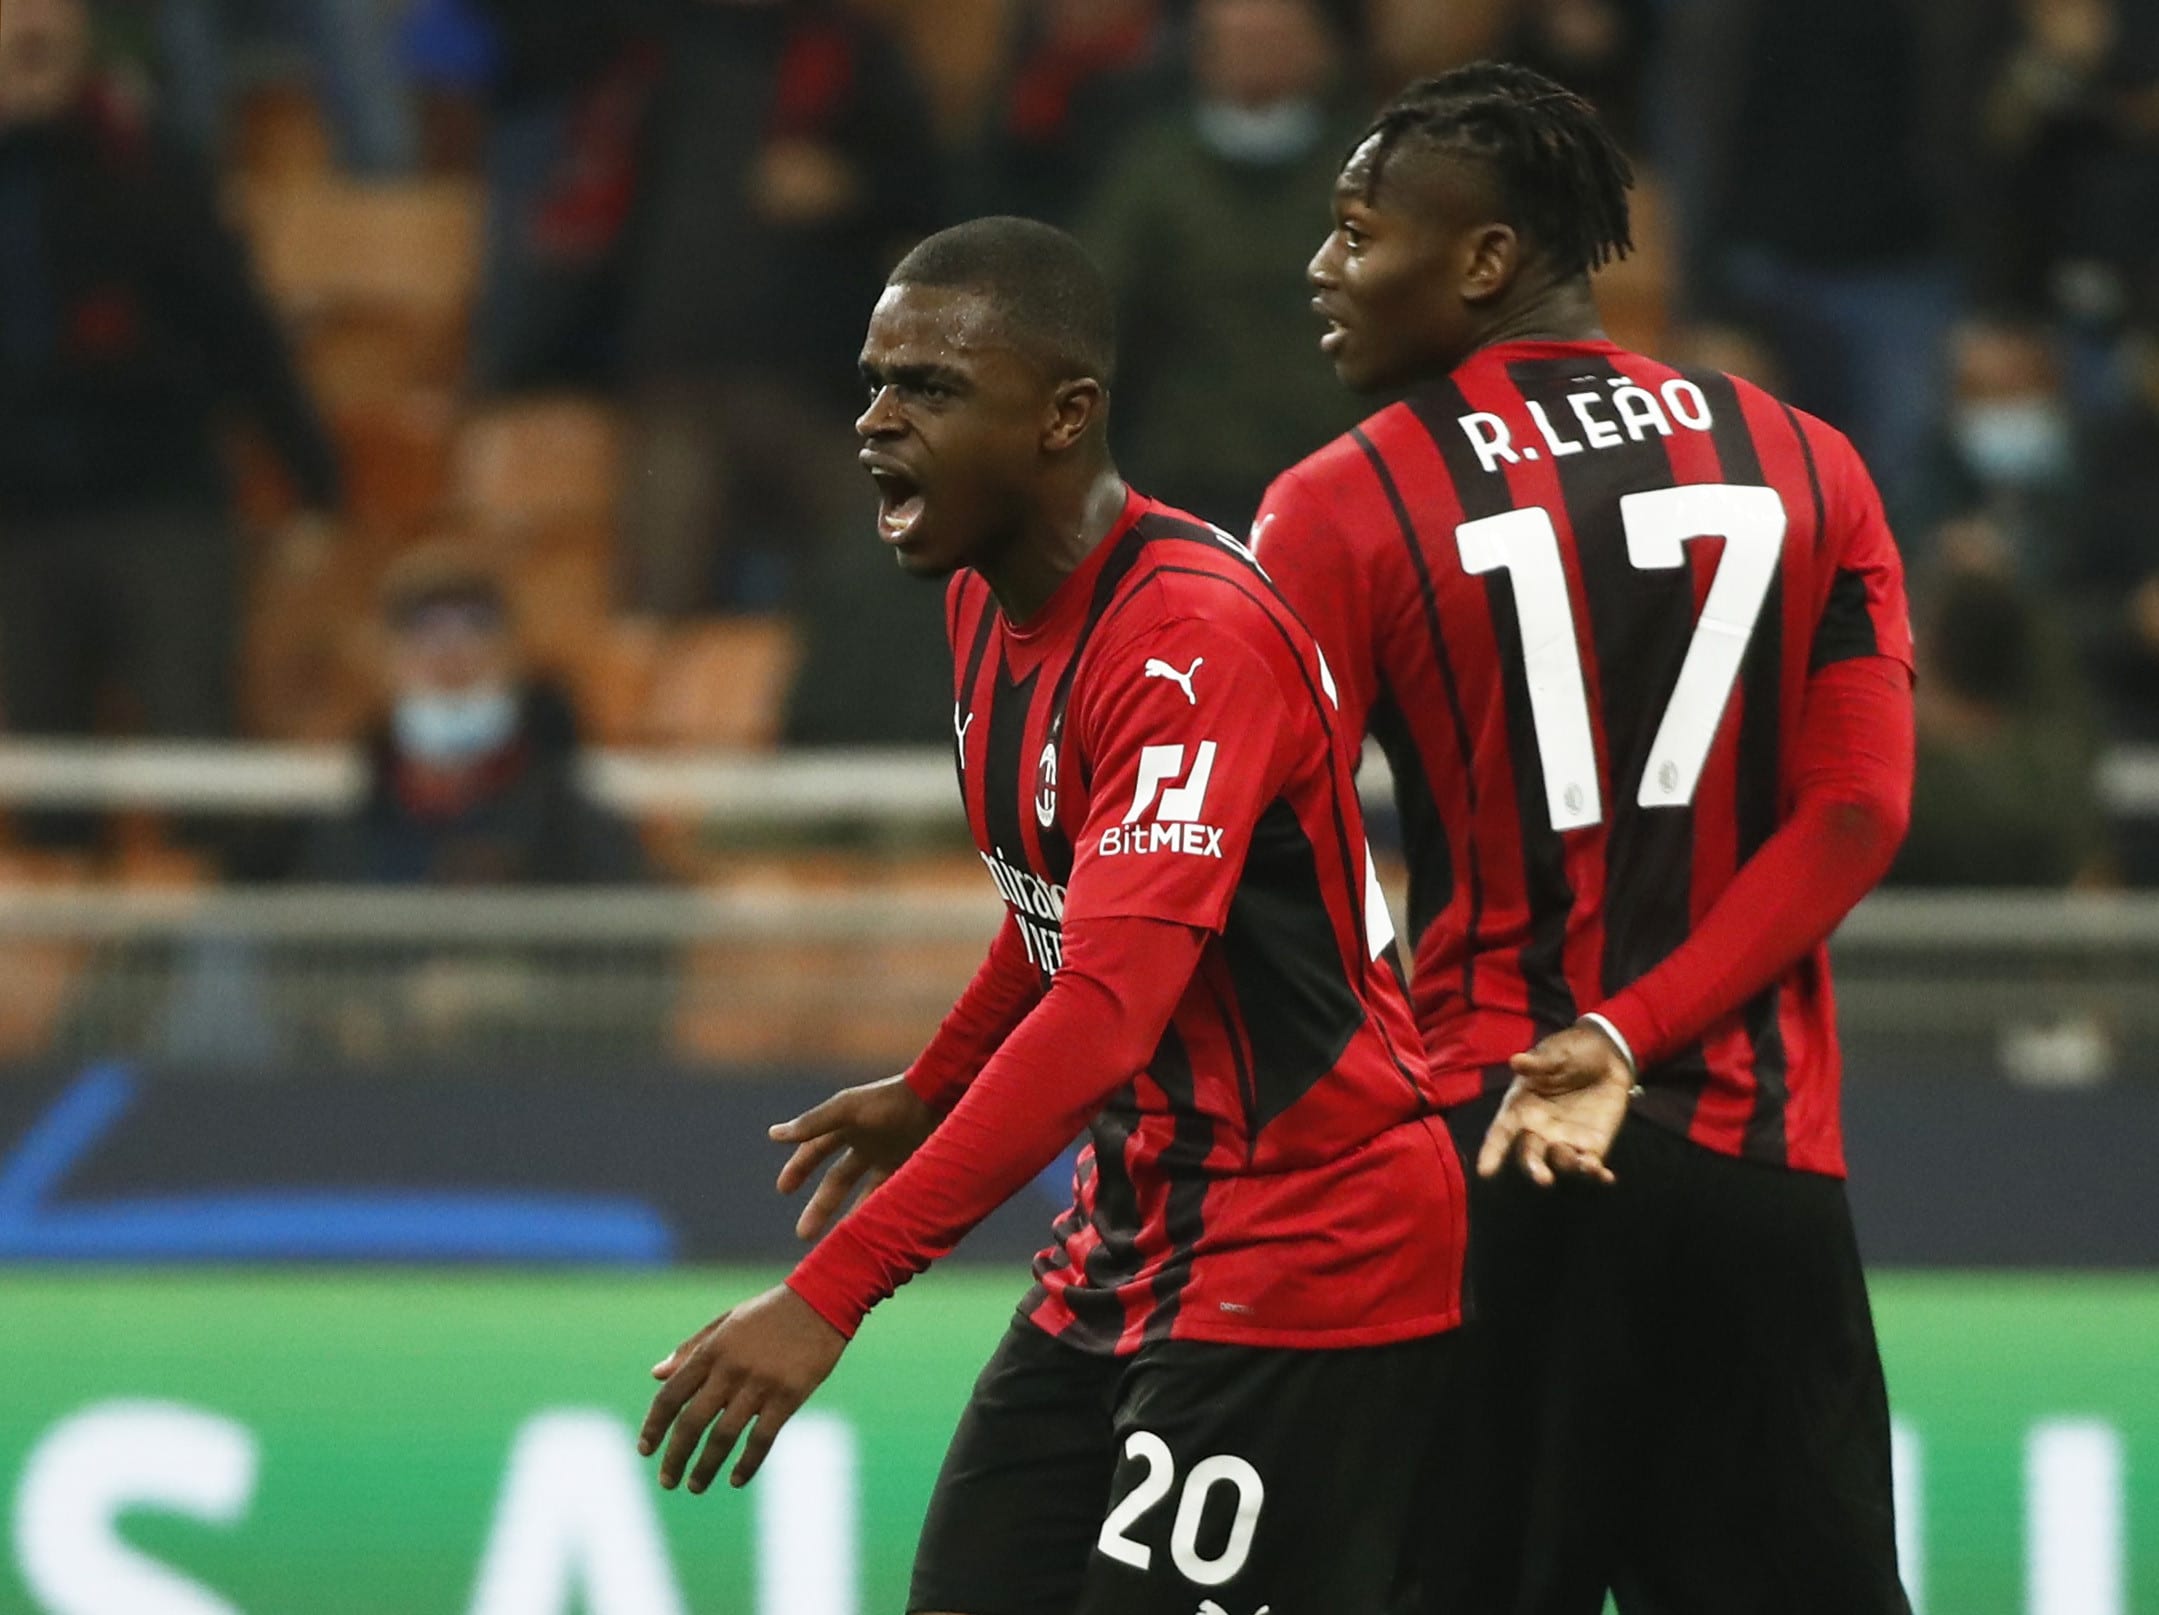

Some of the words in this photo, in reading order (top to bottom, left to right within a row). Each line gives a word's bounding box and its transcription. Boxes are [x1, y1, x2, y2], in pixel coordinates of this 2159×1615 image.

[1457, 376, 1713, 472] R.LEÃO
[1455, 483, 1787, 831] 17
[1099, 822, 1224, 858] BitMEX
[1097, 1430, 1264, 1586] 20
